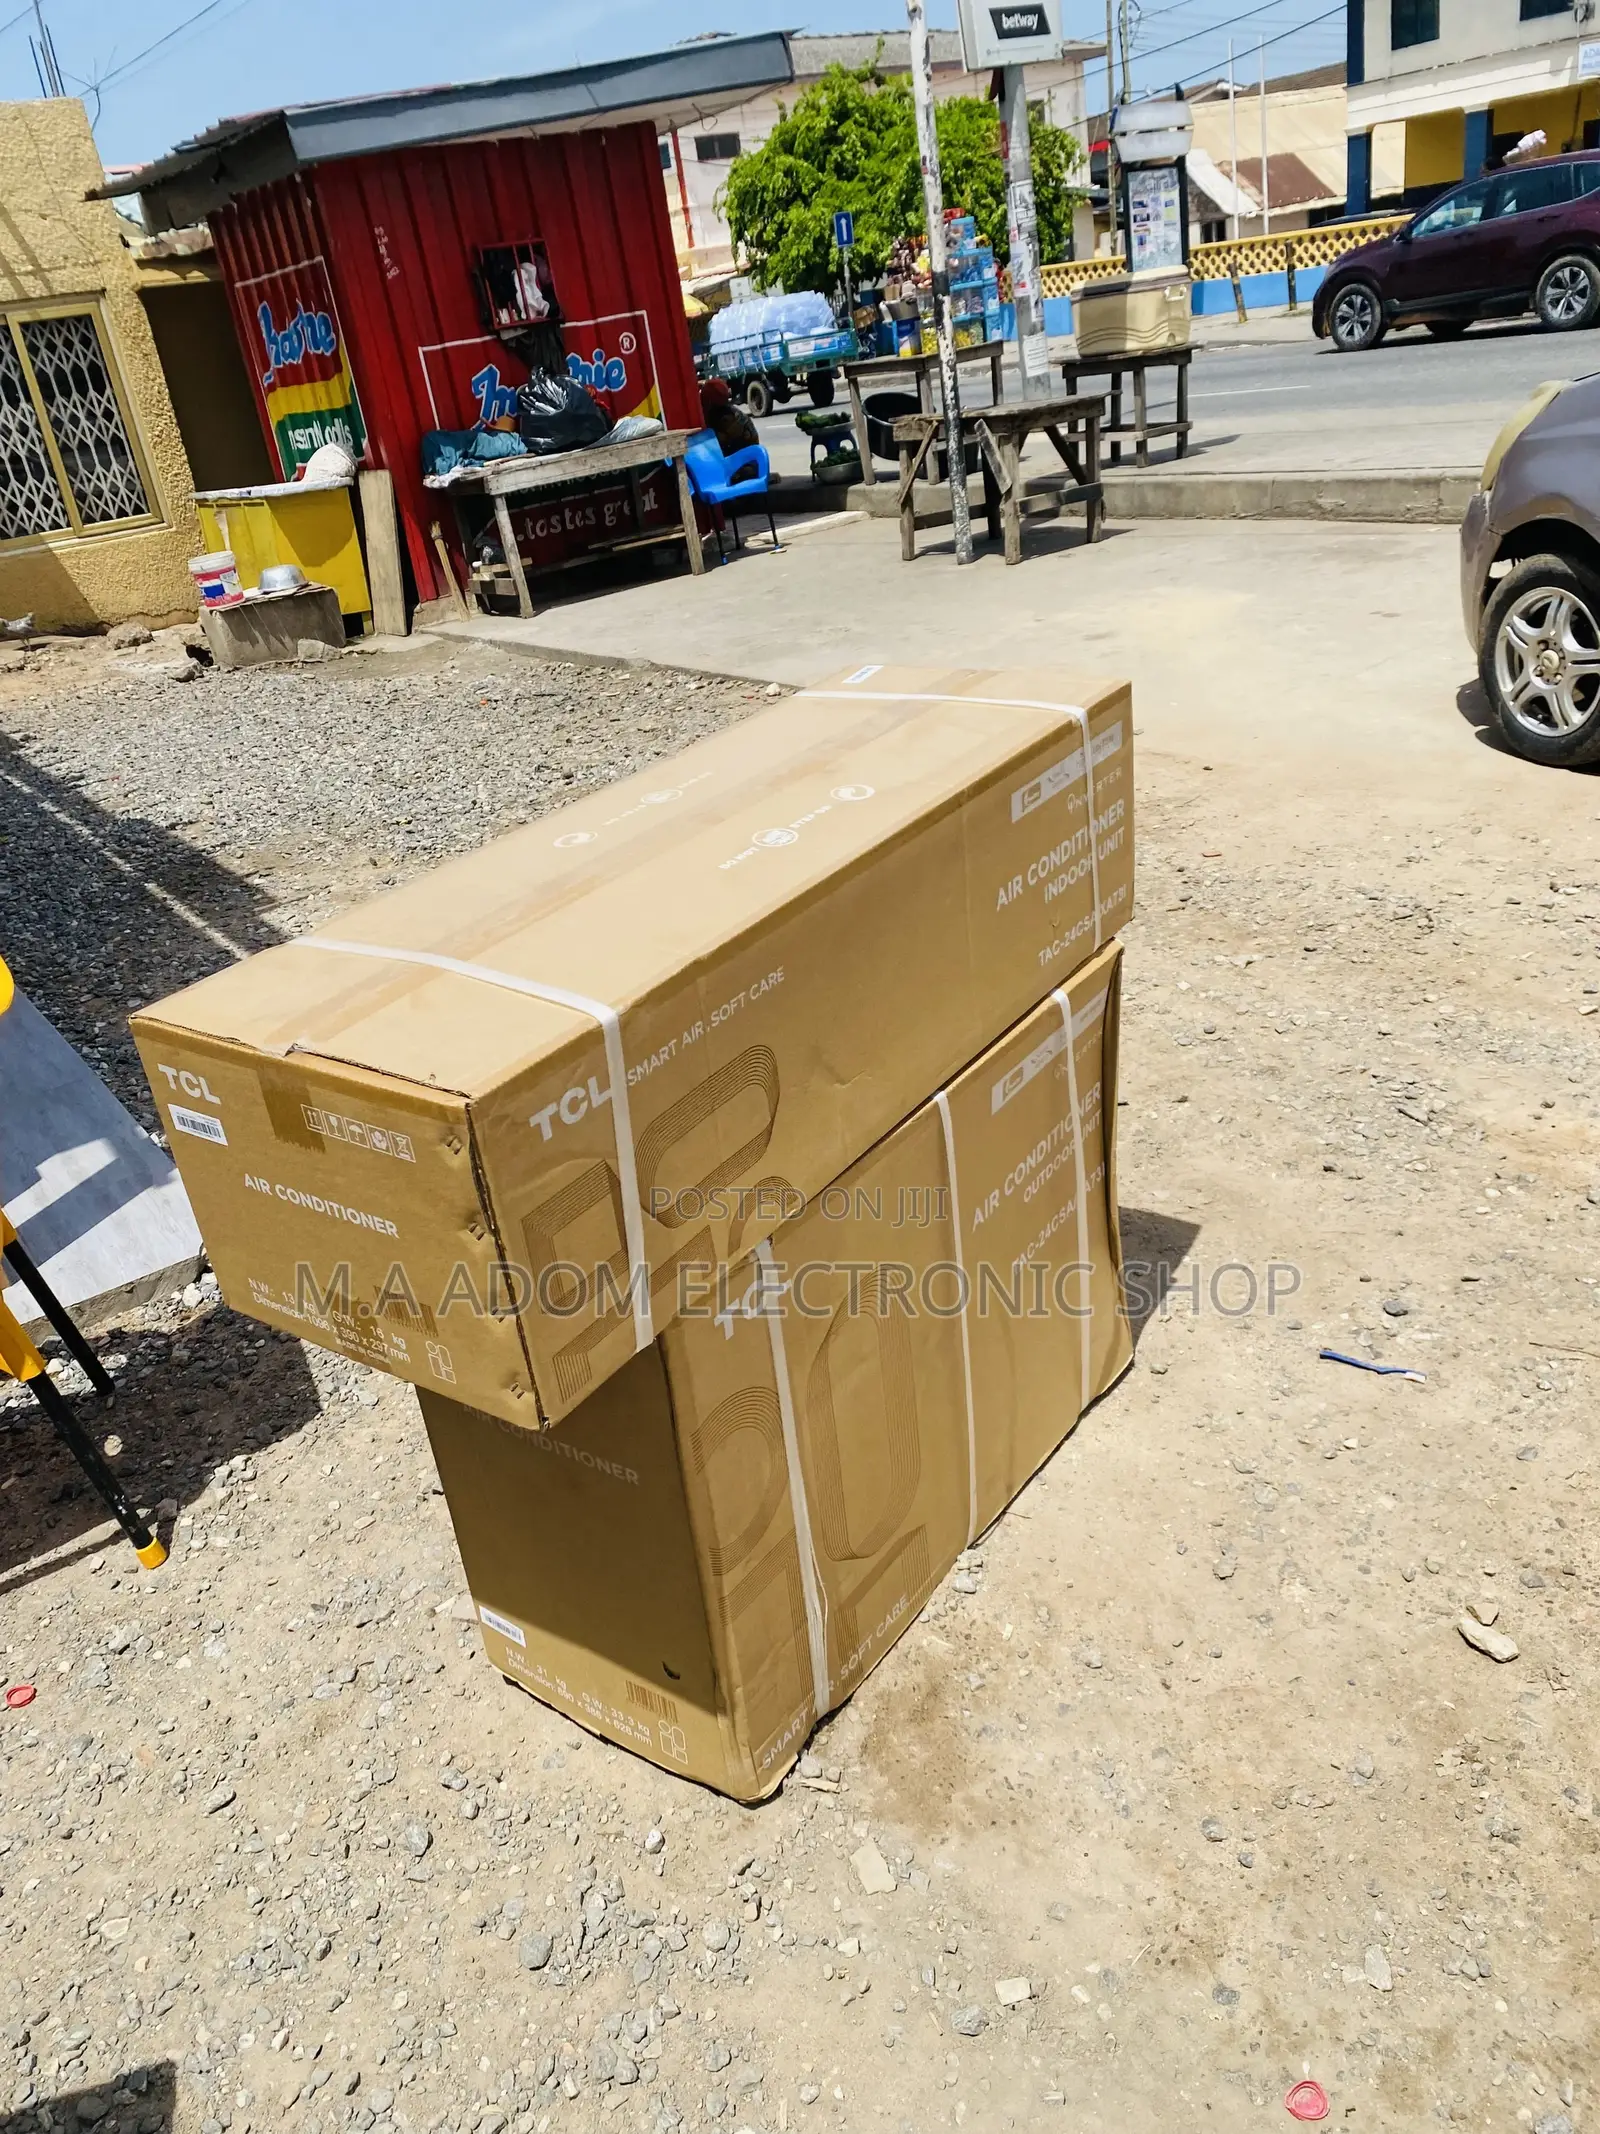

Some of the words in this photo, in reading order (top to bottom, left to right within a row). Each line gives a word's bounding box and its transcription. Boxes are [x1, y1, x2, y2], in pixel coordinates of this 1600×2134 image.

[1002, 13, 1038, 31] betway
[1099, 826, 1124, 860] UNIT
[997, 875, 1023, 911] AIR
[627, 1039, 678, 1086] SMART
[711, 992, 746, 1028] SOFT
[750, 966, 785, 1001] CARE
[157, 1063, 221, 1105] TCL
[529, 1076, 613, 1142] TCL
[245, 1174, 273, 1196] AIR
[275, 1183, 400, 1239] CONDITIONER
[972, 1188, 999, 1232] AIR
[370, 1338, 388, 1354] 297
[390, 1348, 411, 1363] mm
[392, 1333, 406, 1350] kg
[762, 1707, 809, 1768] SMART
[841, 1634, 873, 1680] SOFT
[876, 1595, 909, 1638] CARE
[555, 1676, 566, 1690] kg
[638, 1720, 650, 1737] kg
[634, 1732, 652, 1747] mm
